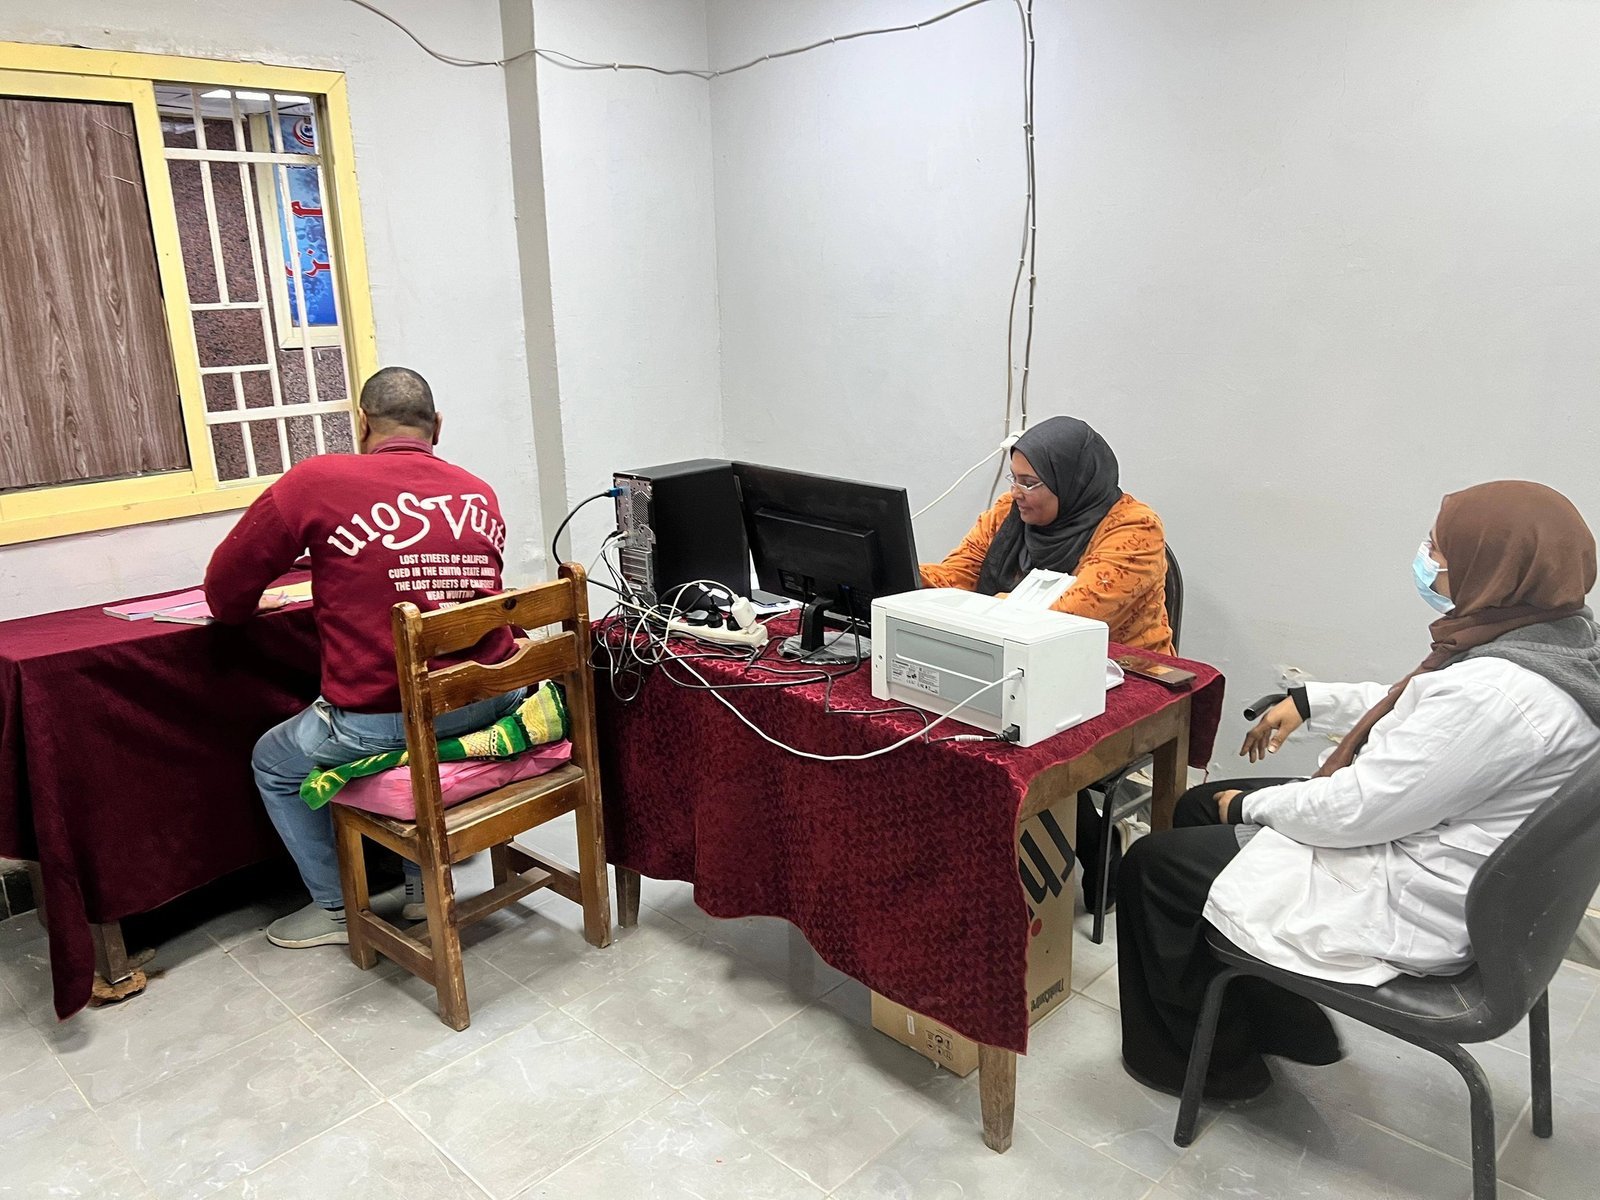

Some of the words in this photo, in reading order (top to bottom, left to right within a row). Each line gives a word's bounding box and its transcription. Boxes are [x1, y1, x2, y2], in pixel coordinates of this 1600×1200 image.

[399, 554, 419, 565] LOST
[451, 554, 461, 564] OF
[421, 566, 438, 576] THE
[462, 566, 481, 577] STATE
[394, 580, 411, 592] THE
[411, 579, 431, 591] LOST
[459, 579, 470, 589] OF
